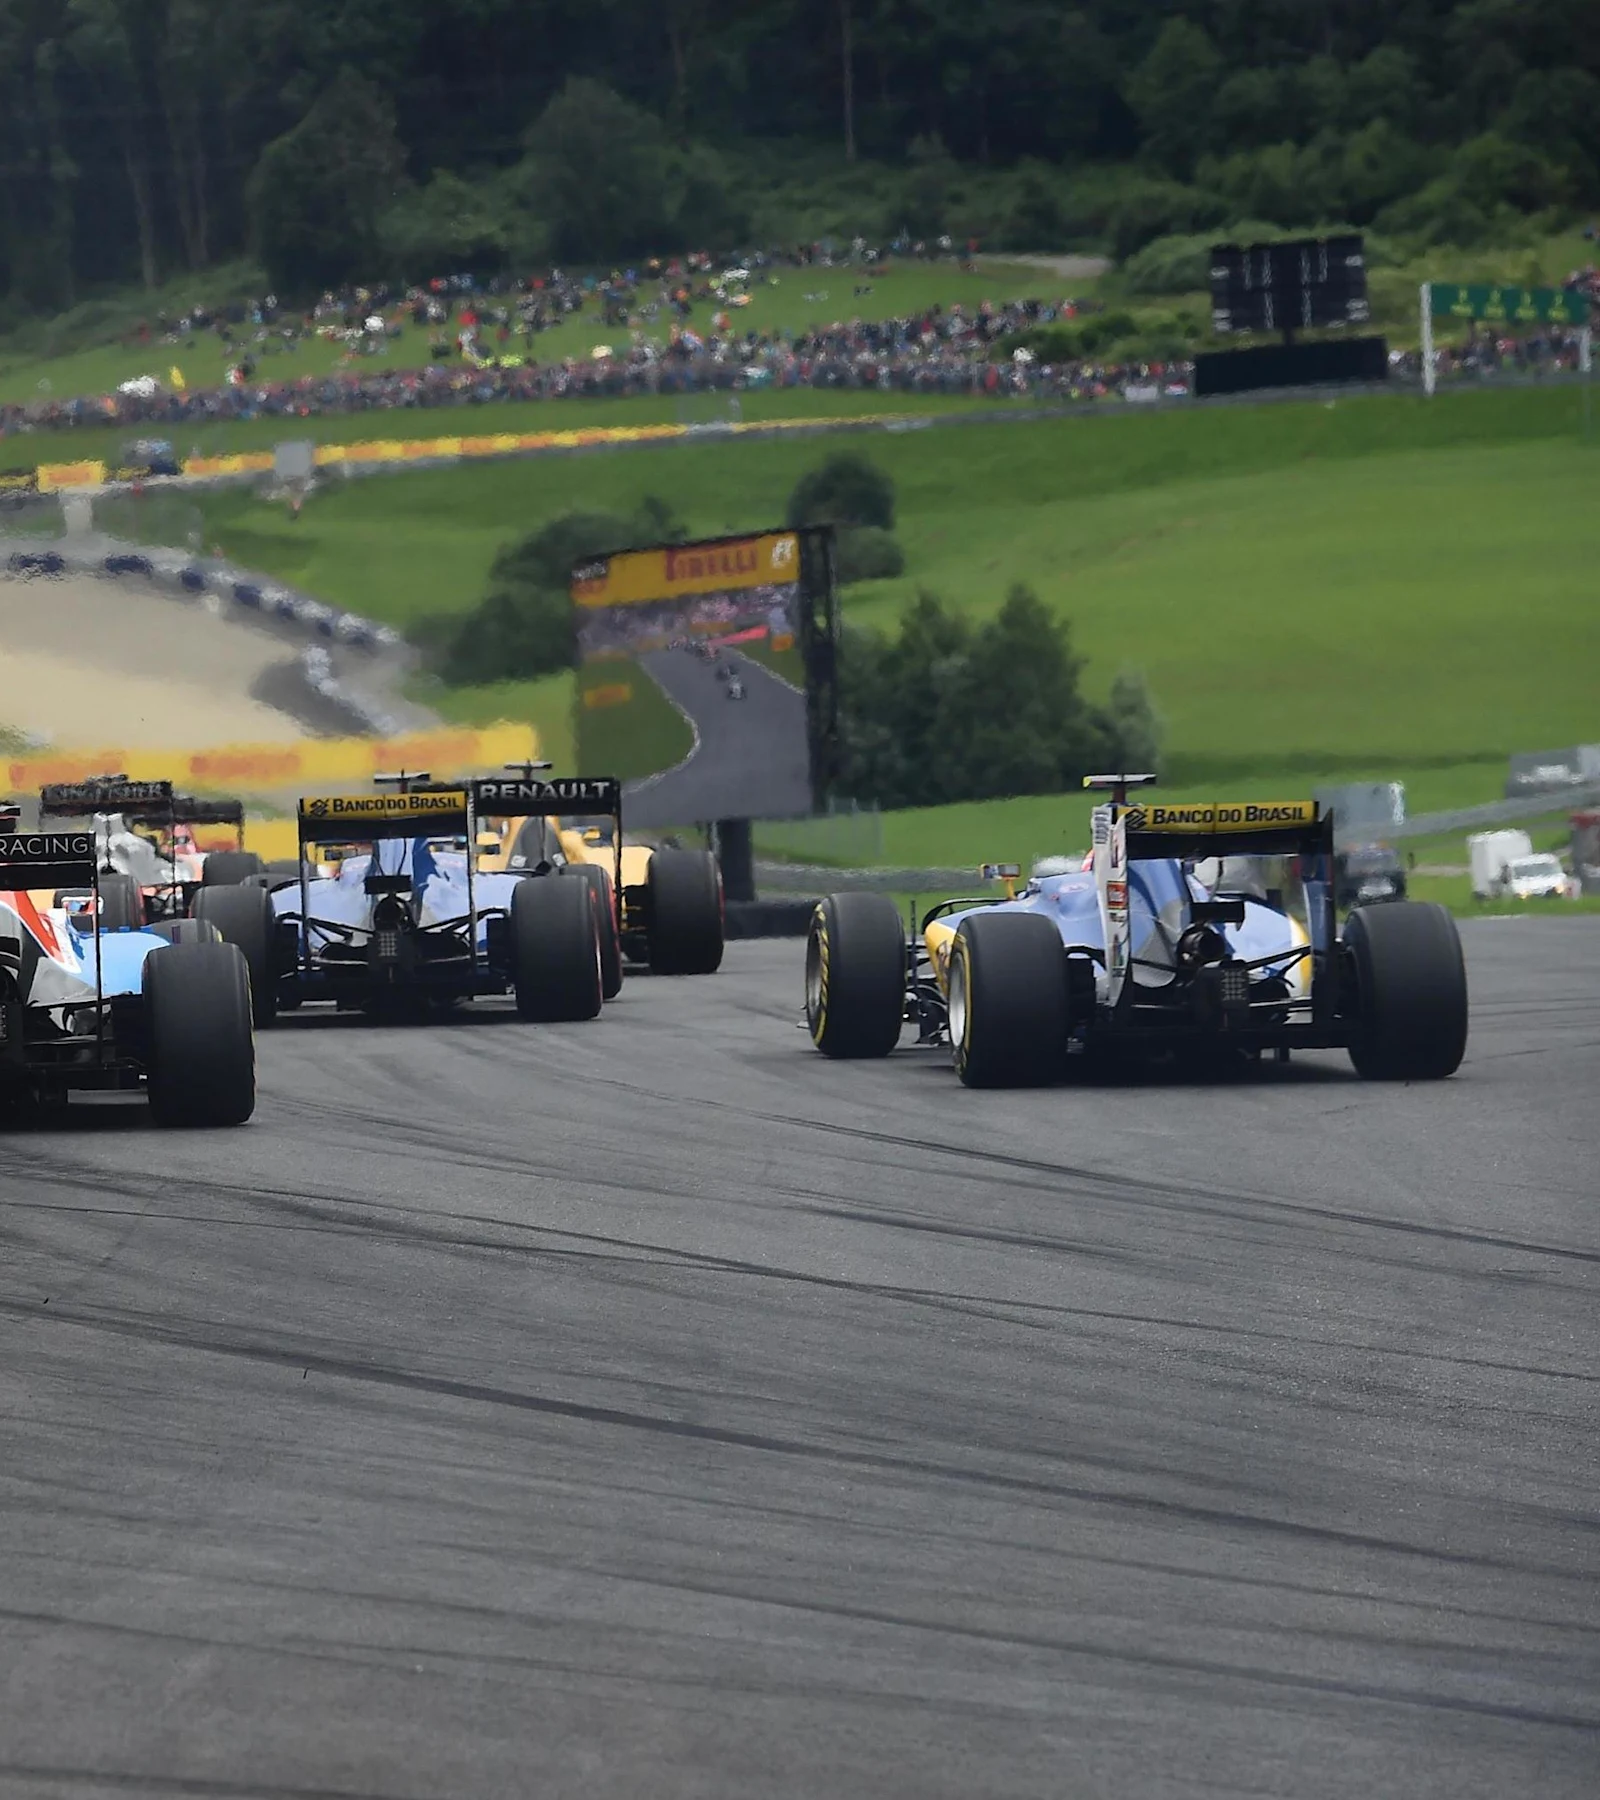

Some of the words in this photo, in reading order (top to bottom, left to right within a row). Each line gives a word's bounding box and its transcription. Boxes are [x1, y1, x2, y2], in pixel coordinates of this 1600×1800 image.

[480, 782, 610, 799] RENAULT
[333, 799, 384, 813] BANCO
[386, 799, 406, 810] DO
[409, 796, 459, 809] BRASIL
[1153, 808, 1213, 825] BANCO
[1218, 808, 1241, 823] DO
[1245, 805, 1306, 822] BRASIL
